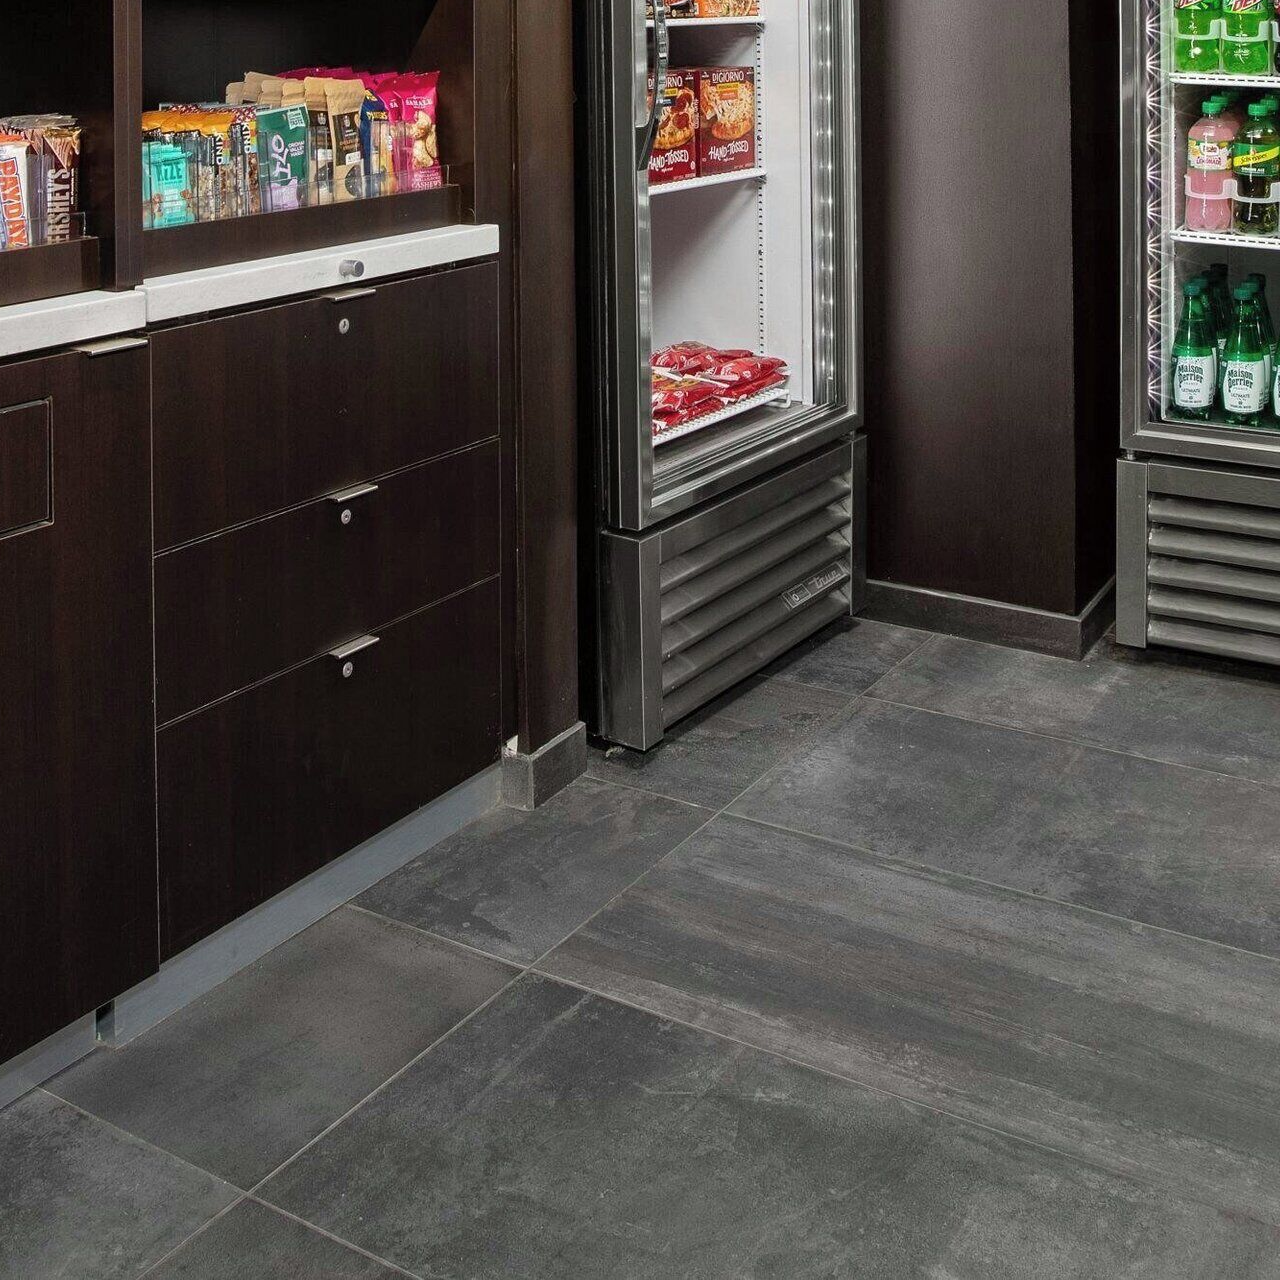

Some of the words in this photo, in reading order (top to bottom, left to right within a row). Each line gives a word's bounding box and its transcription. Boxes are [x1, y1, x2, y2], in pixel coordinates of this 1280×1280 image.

[712, 70, 744, 82] DIGIORNO
[242, 122, 251, 154] KIND
[215, 132, 225, 165] KIND
[47, 168, 70, 243] ERSHEY'S
[1178, 365, 1203, 375] Maison
[1227, 370, 1254, 380] Maison
[1178, 373, 1203, 387] Perrier
[1228, 378, 1253, 392] Perrier
